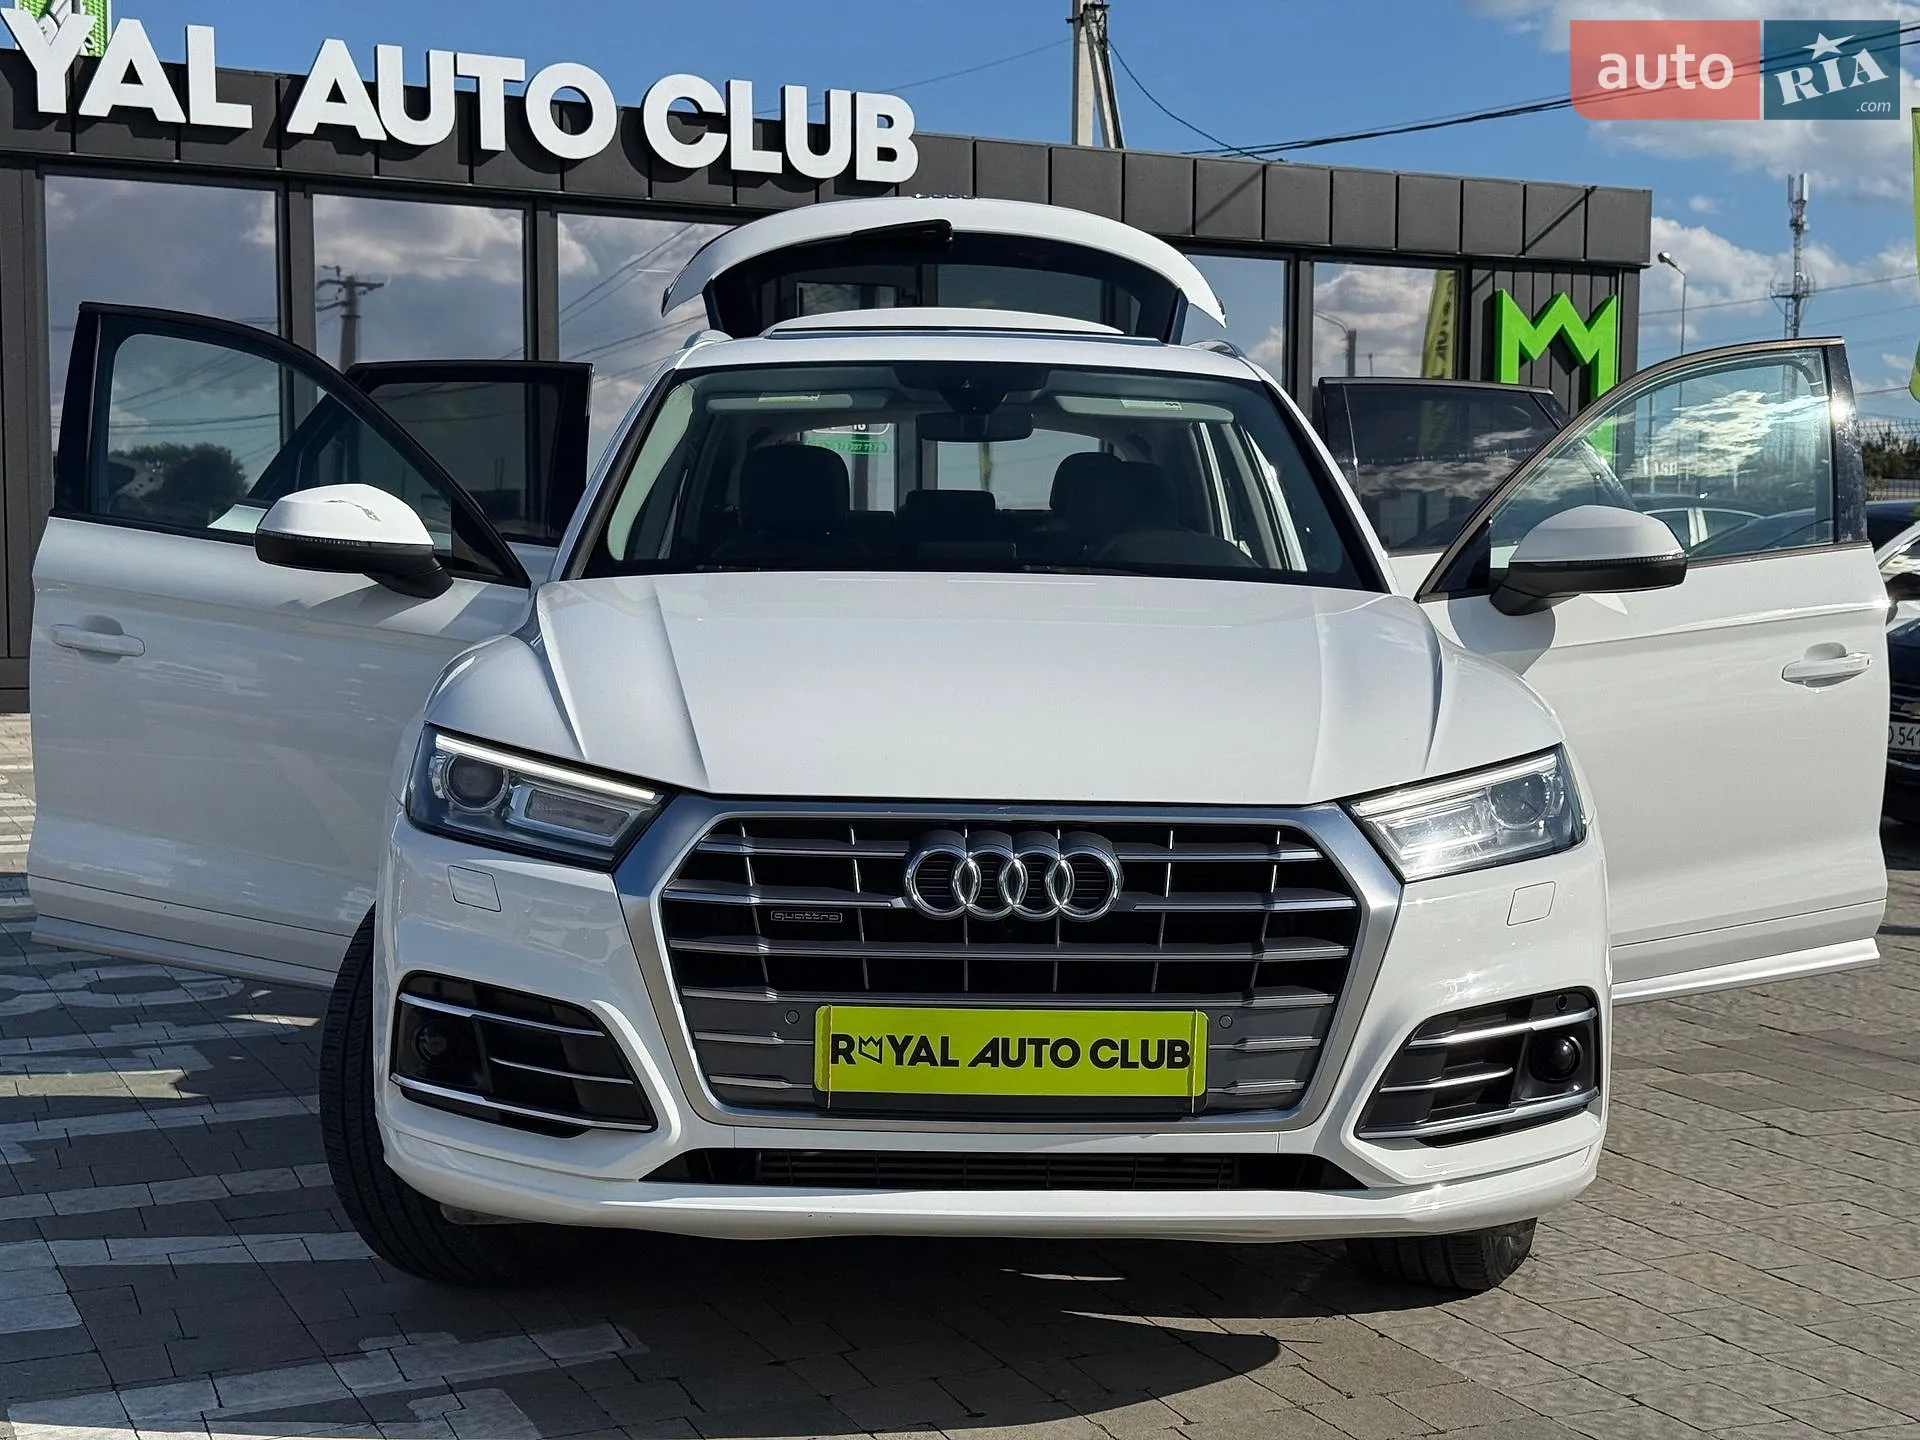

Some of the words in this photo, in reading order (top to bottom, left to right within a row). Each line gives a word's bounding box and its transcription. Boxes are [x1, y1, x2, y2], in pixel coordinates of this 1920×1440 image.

[286, 38, 618, 161] AUTO
[642, 73, 919, 185] CLUB
[774, 912, 839, 921] quattro
[967, 1037, 1082, 1069] AUTO
[1089, 1038, 1191, 1070] CLUB
